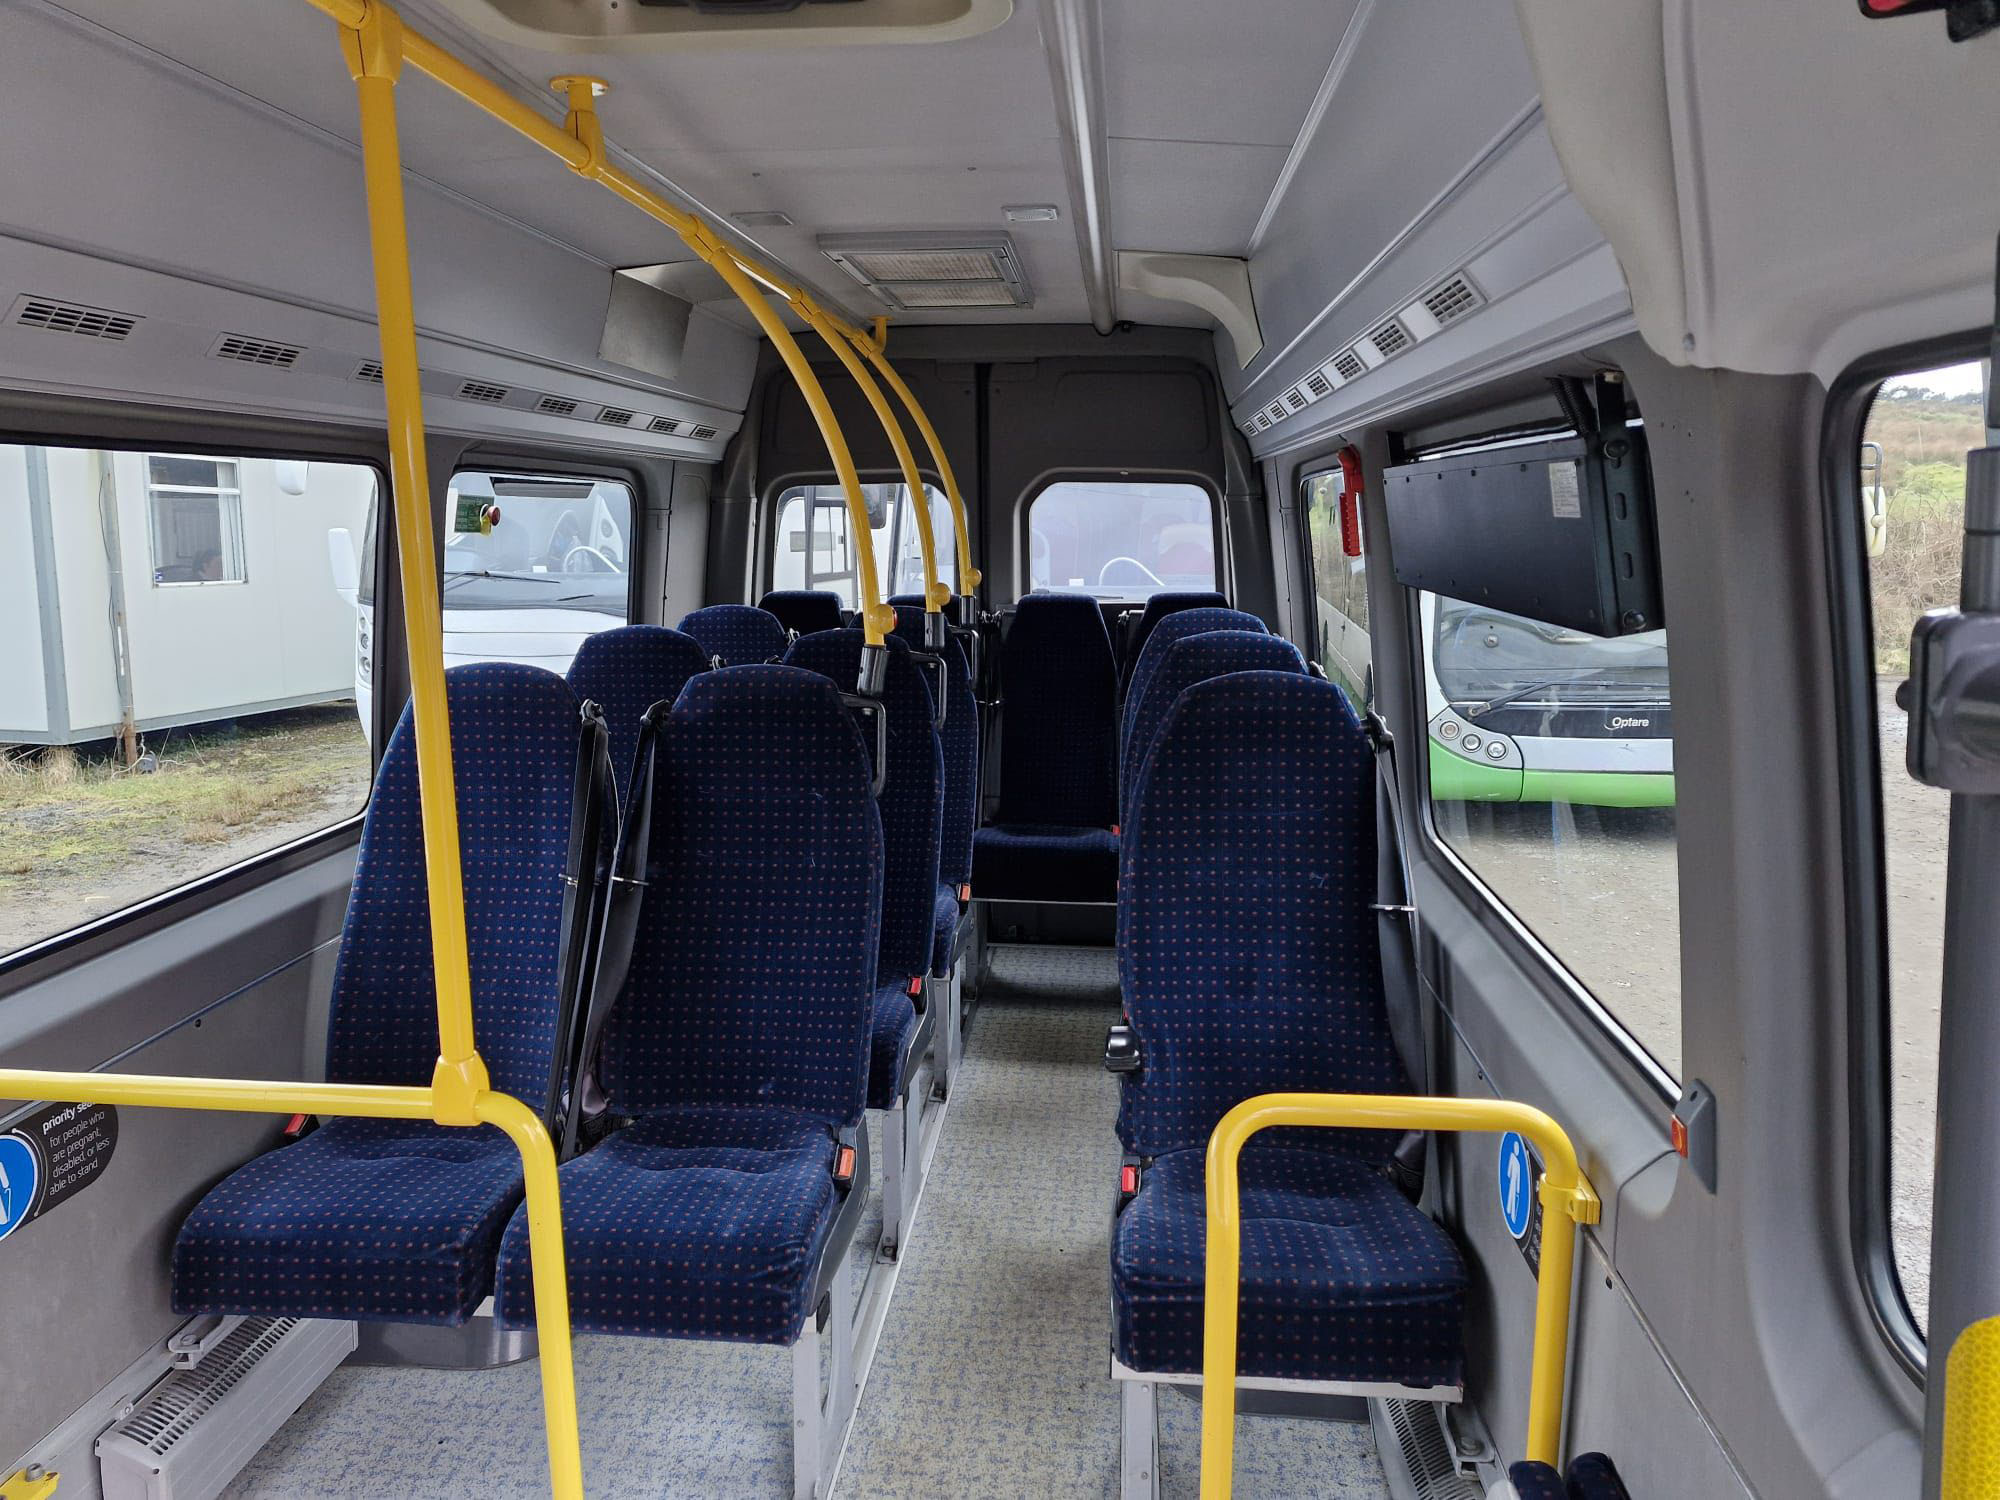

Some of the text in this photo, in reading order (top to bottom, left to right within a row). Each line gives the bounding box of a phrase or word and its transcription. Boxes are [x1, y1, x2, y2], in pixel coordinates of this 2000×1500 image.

[1612, 717, 1649, 728] Optare
[42, 1106, 76, 1135] priority
[49, 1111, 105, 1148] for people who
[52, 1149, 65, 1163] are
[87, 1145, 96, 1157] or
[96, 1137, 110, 1151] less
[49, 1158, 98, 1196] able to stand
